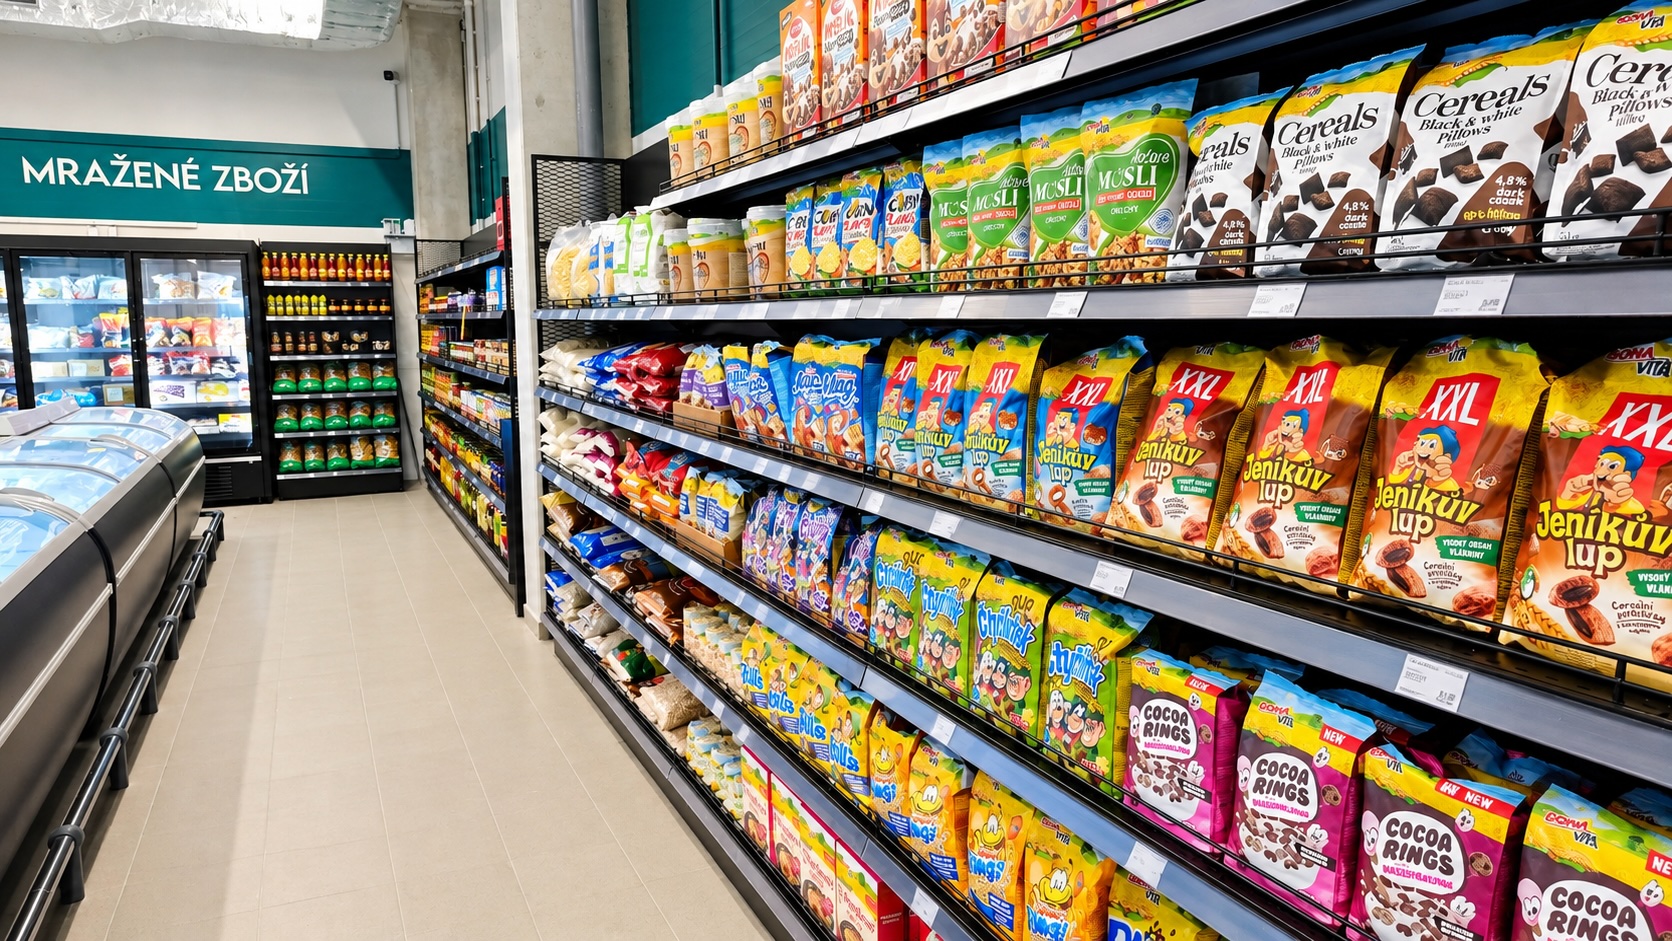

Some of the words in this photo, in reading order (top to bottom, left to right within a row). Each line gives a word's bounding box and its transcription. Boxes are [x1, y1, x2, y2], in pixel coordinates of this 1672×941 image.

[1413, 74, 1552, 118] Cereals
[1592, 86, 1635, 105] Black
[1277, 102, 1380, 146] Cereals
[1419, 118, 1463, 131] Black
[1465, 116, 1477, 128] &
[1481, 106, 1523, 124] white
[1281, 145, 1310, 159] Black
[1324, 135, 1358, 152] white
[1436, 125, 1492, 145] Pillows
[21, 153, 201, 191] MRAŽENÉ
[211, 162, 309, 195] ZBOŽÍ
[1294, 152, 1334, 170] Pillows
[1098, 165, 1157, 191] MÜSLI
[1496, 187, 1525, 198] dark
[1637, 360, 1671, 377] VITA
[1062, 381, 1106, 406] XXL
[1169, 368, 1222, 401] XXL
[1420, 382, 1480, 426] XXL
[1145, 459, 1172, 482] lup
[1243, 453, 1333, 491] Jeníkův
[1258, 480, 1294, 508] lup
[1375, 477, 1480, 524] Jeníkův
[1390, 508, 1435, 541] lup
[1565, 538, 1623, 576] lup
[1143, 704, 1189, 727] COCOA
[1142, 721, 1192, 745] RINGS
[1323, 728, 1346, 746] NEW
[1255, 758, 1309, 786] COCOA
[1252, 777, 1310, 807] RINGS
[1464, 790, 1494, 810] NEW
[1385, 817, 1452, 853] COCOA
[1382, 839, 1455, 876] RINGS
[1550, 886, 1637, 930] COCOA
